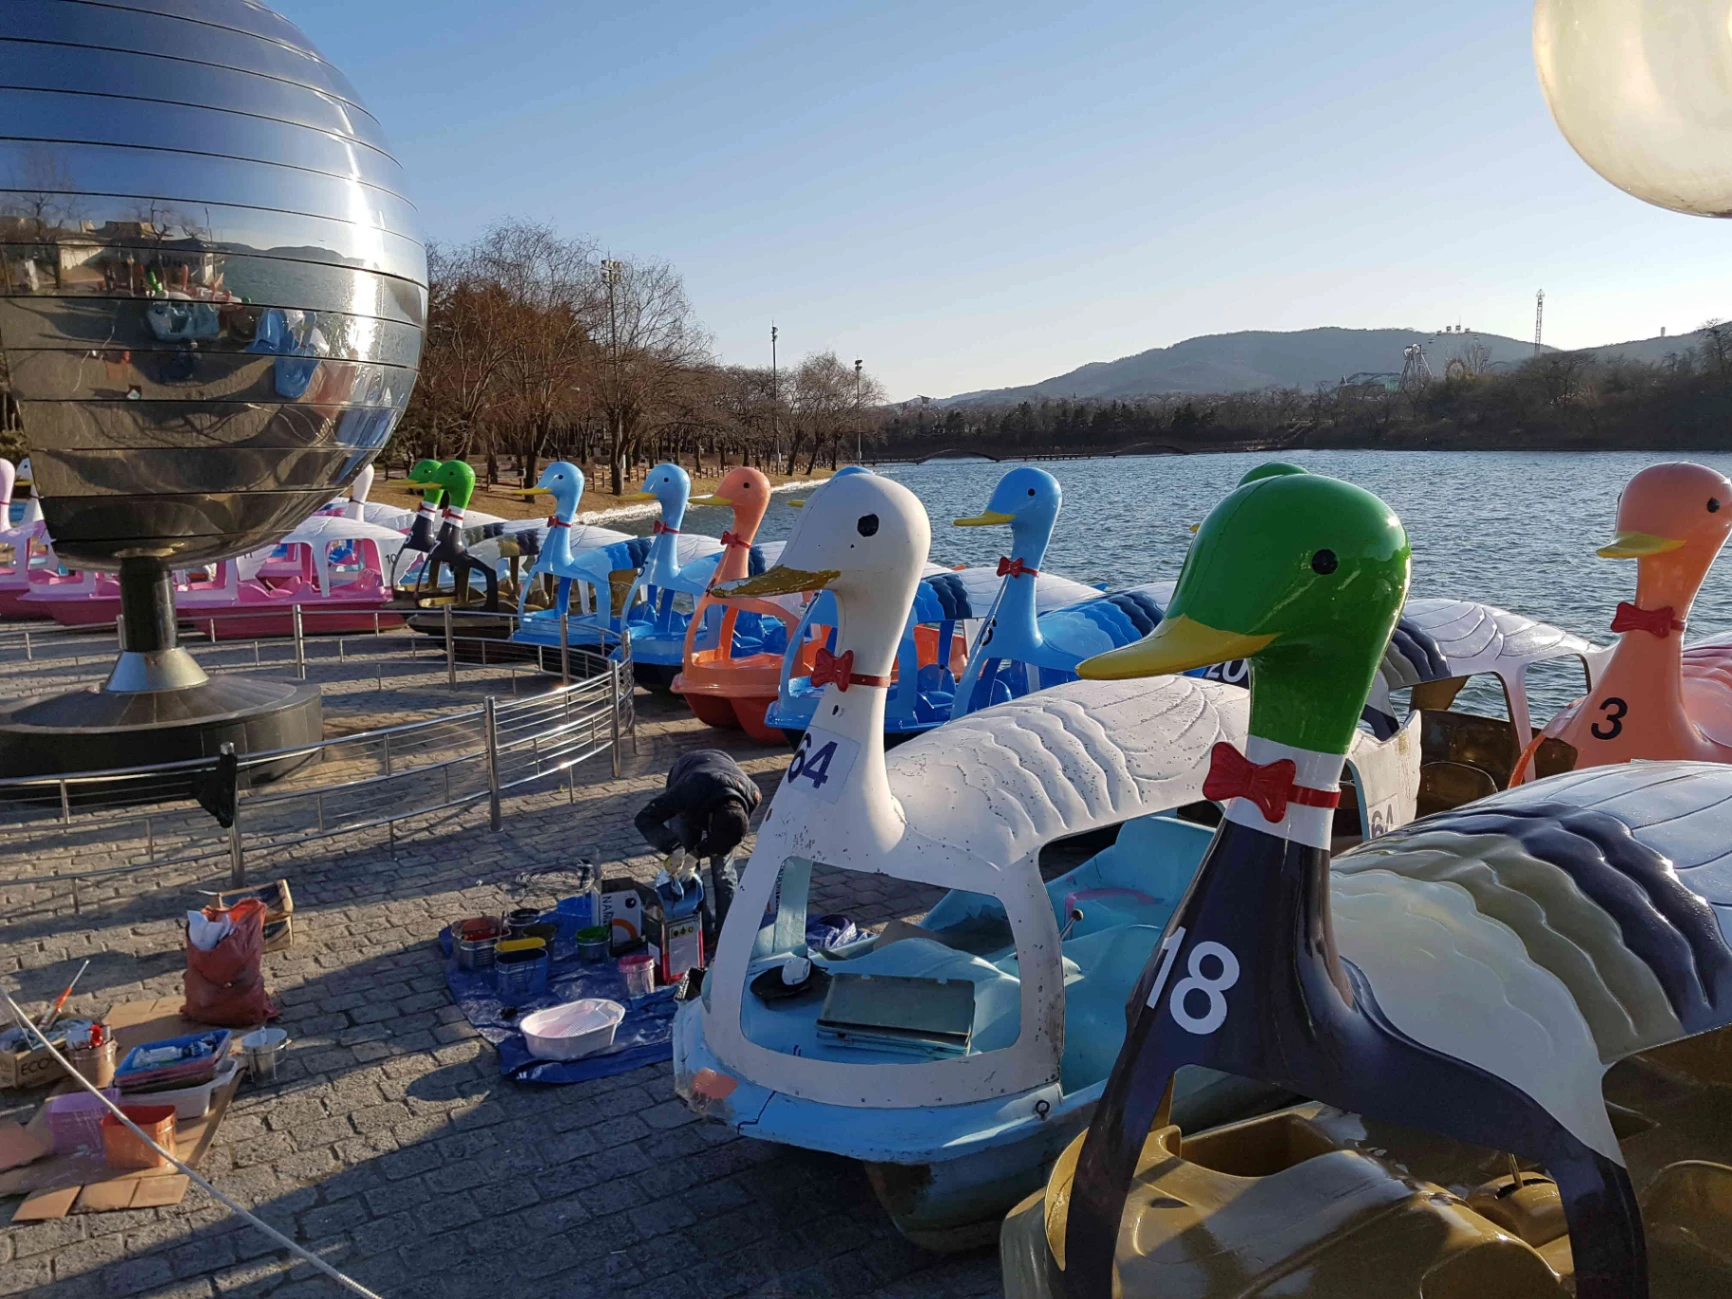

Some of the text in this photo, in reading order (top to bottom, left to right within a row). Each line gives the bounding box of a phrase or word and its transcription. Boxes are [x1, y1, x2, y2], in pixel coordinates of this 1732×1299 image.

[385, 553, 398, 565] 10
[1590, 696, 1628, 741] 3
[787, 732, 838, 789] 64
[1145, 925, 1240, 1035] 18
